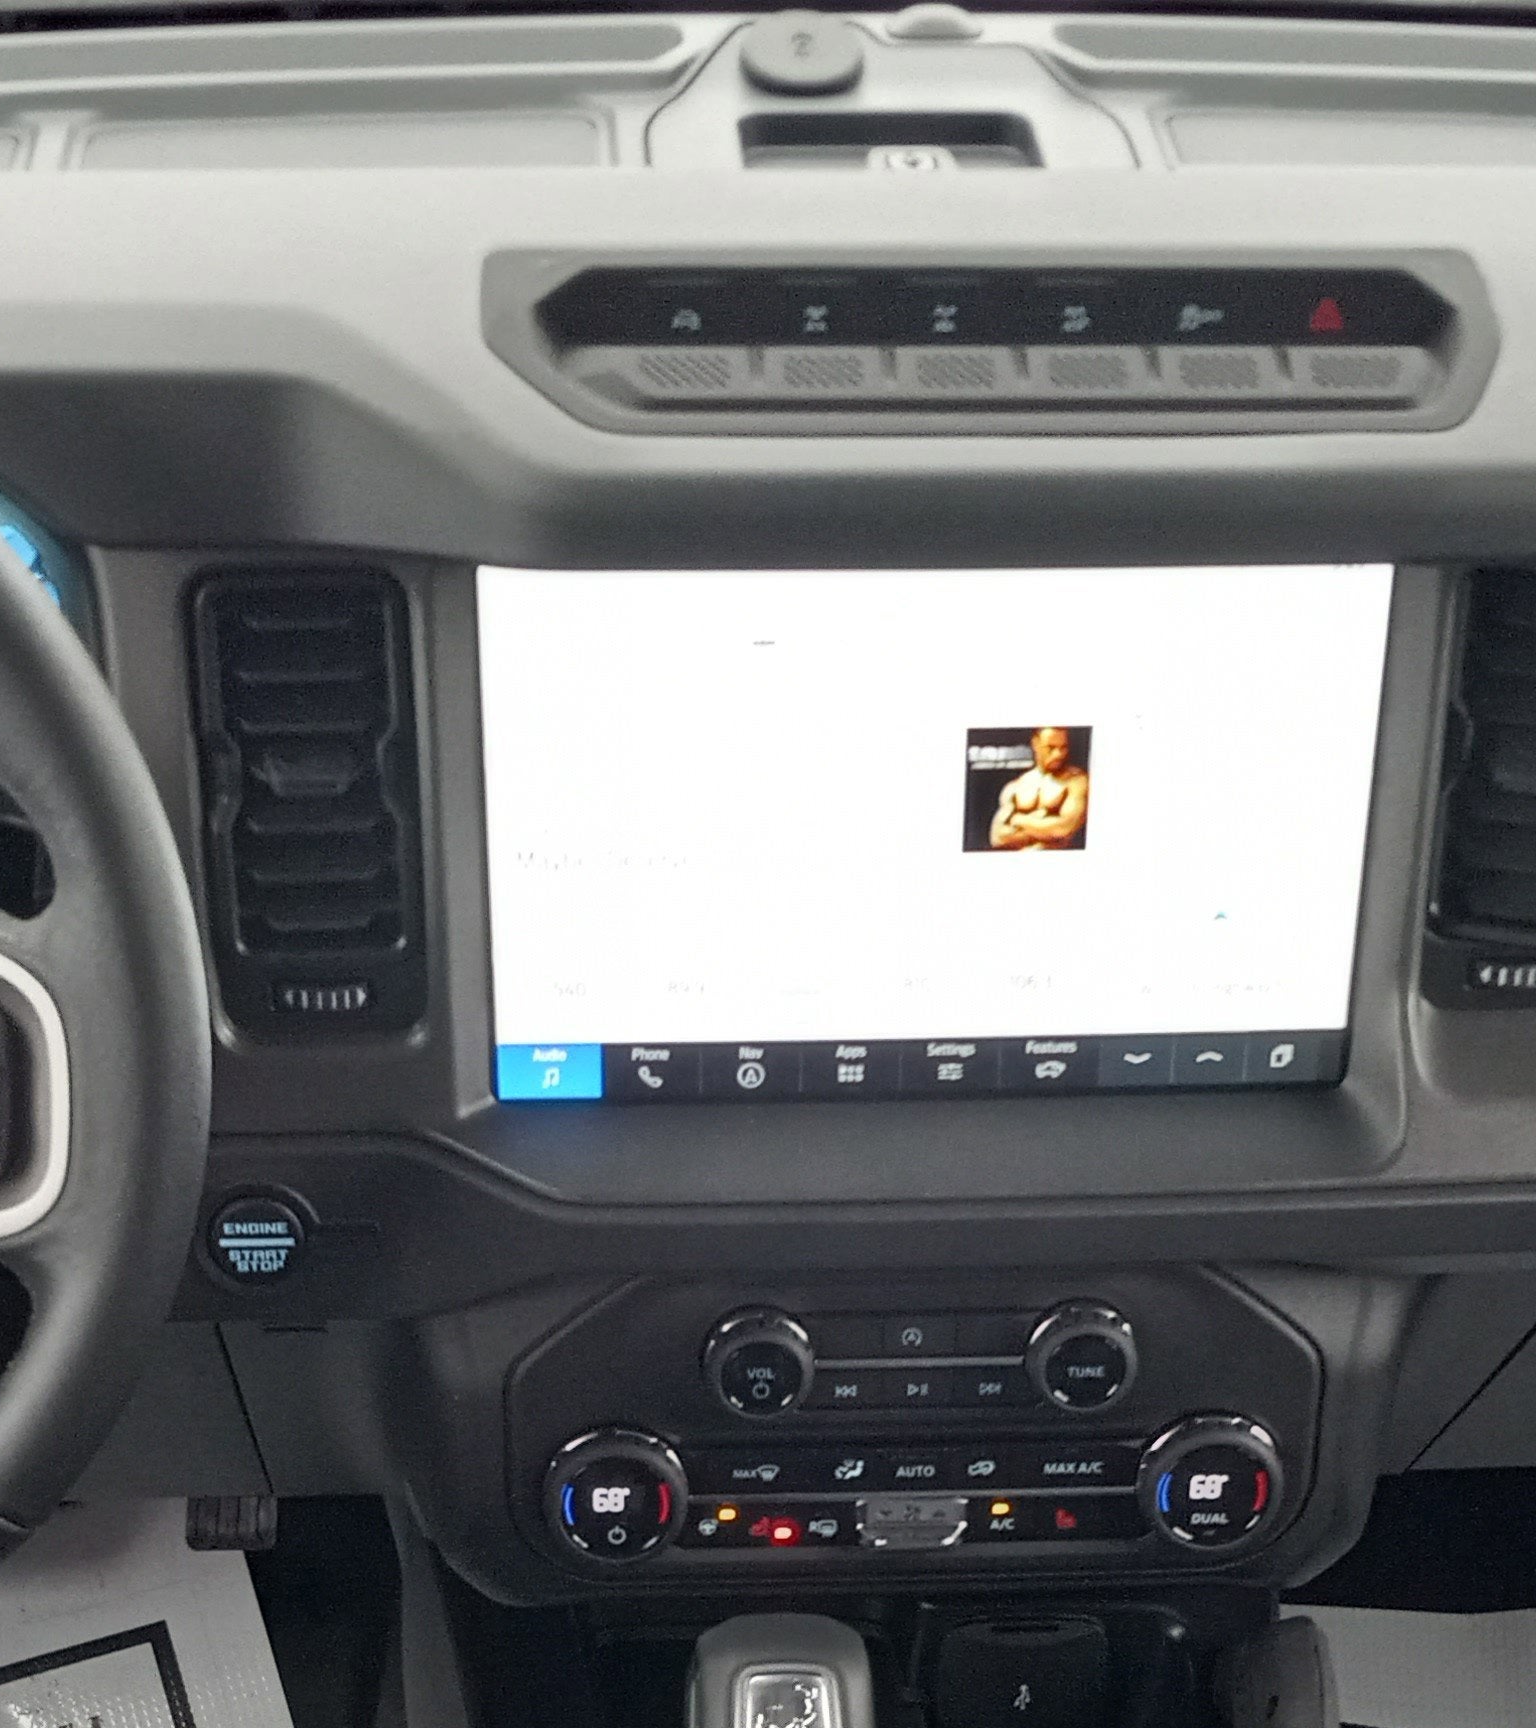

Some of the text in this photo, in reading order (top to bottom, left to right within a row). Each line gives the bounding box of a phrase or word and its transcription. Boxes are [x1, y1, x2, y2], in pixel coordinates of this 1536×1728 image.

[532, 1047, 567, 1062] Audio
[631, 1046, 670, 1062] Phone
[739, 1046, 765, 1060] Nav
[836, 1044, 866, 1060] Apps
[926, 1042, 976, 1058] Settings
[1025, 1040, 1078, 1055] Features
[223, 1222, 289, 1235] ENGINE
[228, 1249, 289, 1262] START
[747, 1367, 775, 1380] VOL
[1066, 1366, 1105, 1378] TUNE
[732, 1468, 757, 1479] MAX
[895, 1465, 936, 1478] AUTO
[1043, 1460, 1105, 1475] MAX A/C
[990, 1517, 1015, 1531] A/C
[1190, 1511, 1230, 1525] DUAL
